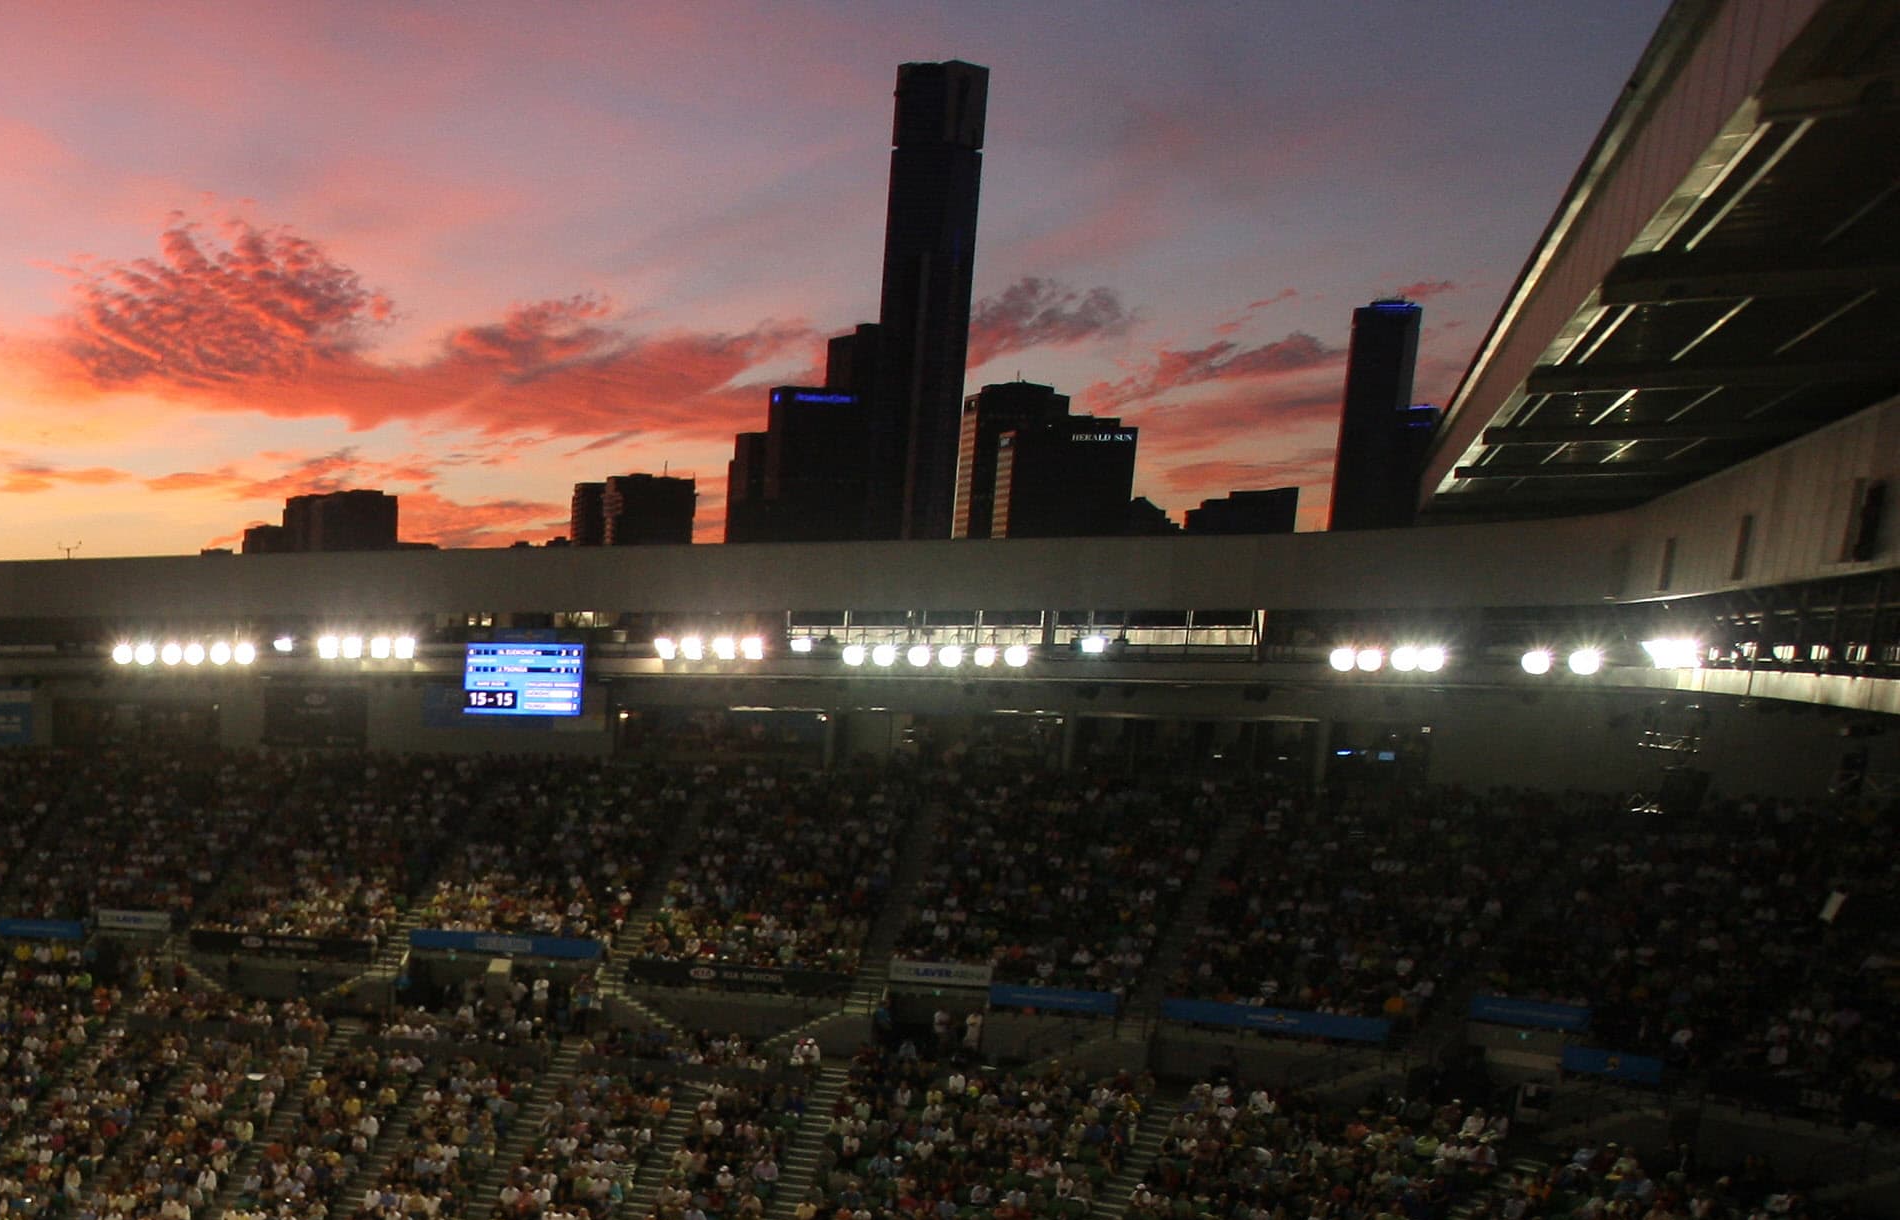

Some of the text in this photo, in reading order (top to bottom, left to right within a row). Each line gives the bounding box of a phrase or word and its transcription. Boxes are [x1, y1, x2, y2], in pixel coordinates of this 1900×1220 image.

[1071, 433, 1133, 441] HERALD SUN
[469, 692, 514, 706] 15-15
